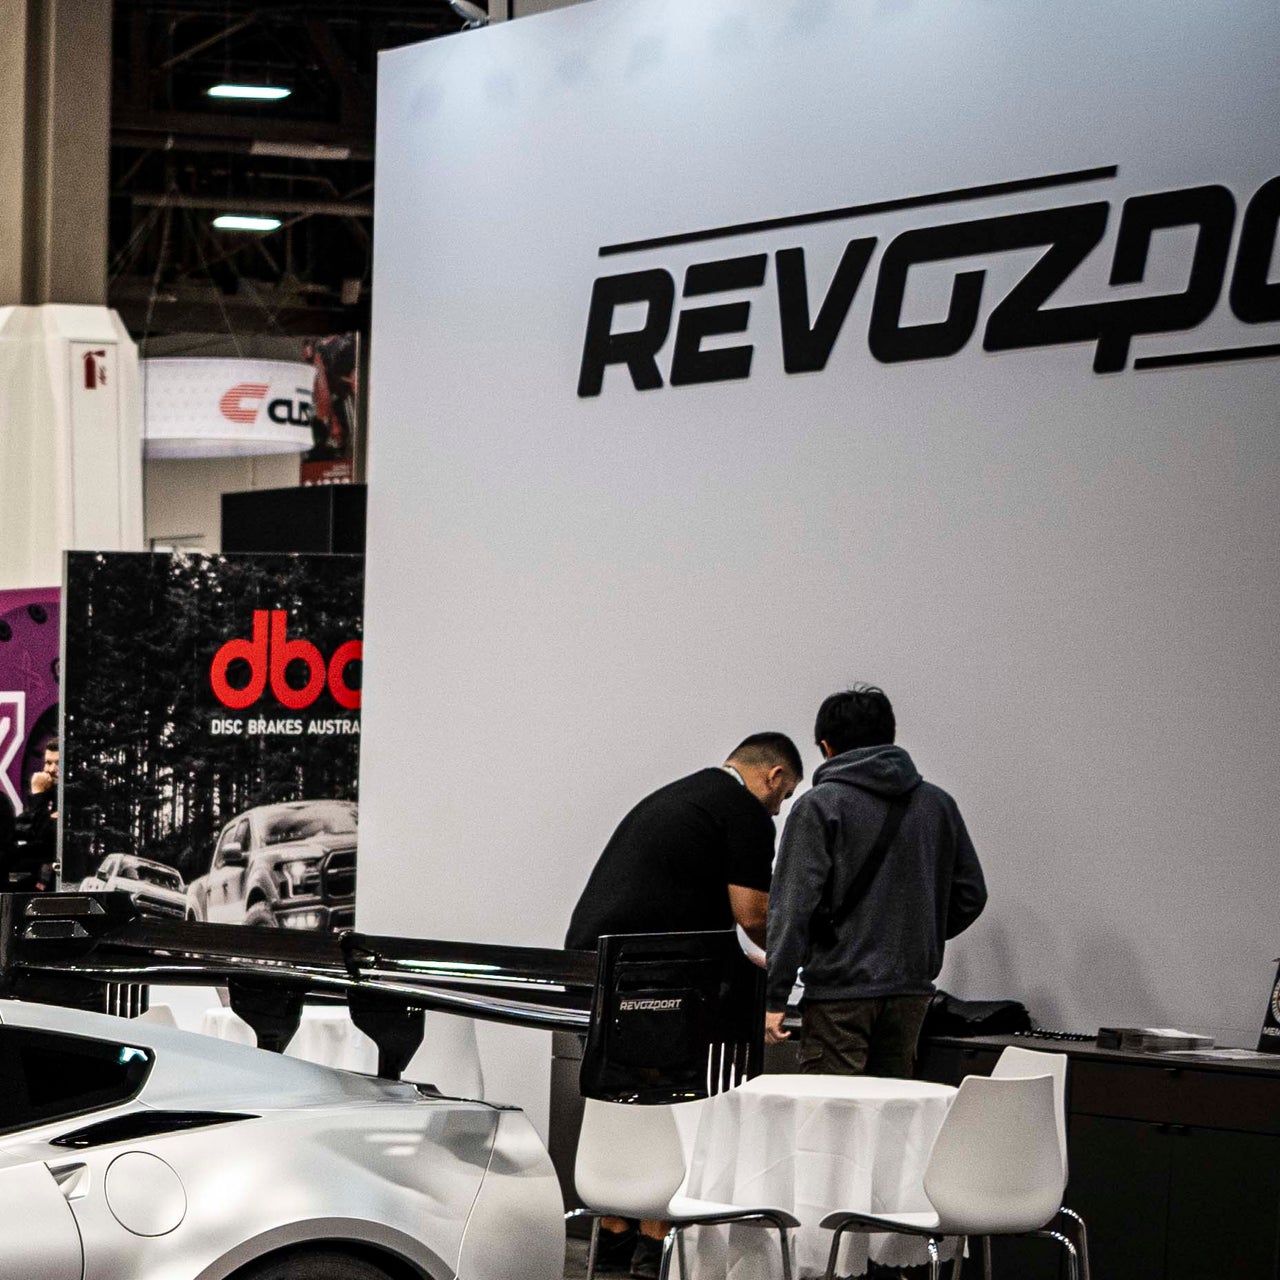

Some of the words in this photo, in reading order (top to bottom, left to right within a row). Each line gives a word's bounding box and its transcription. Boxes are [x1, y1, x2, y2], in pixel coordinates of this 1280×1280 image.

[211, 719, 243, 735] DISC
[248, 719, 303, 735] BRAKES
[307, 719, 362, 735] AUSTRA
[620, 999, 682, 1012] REVOZPORT
